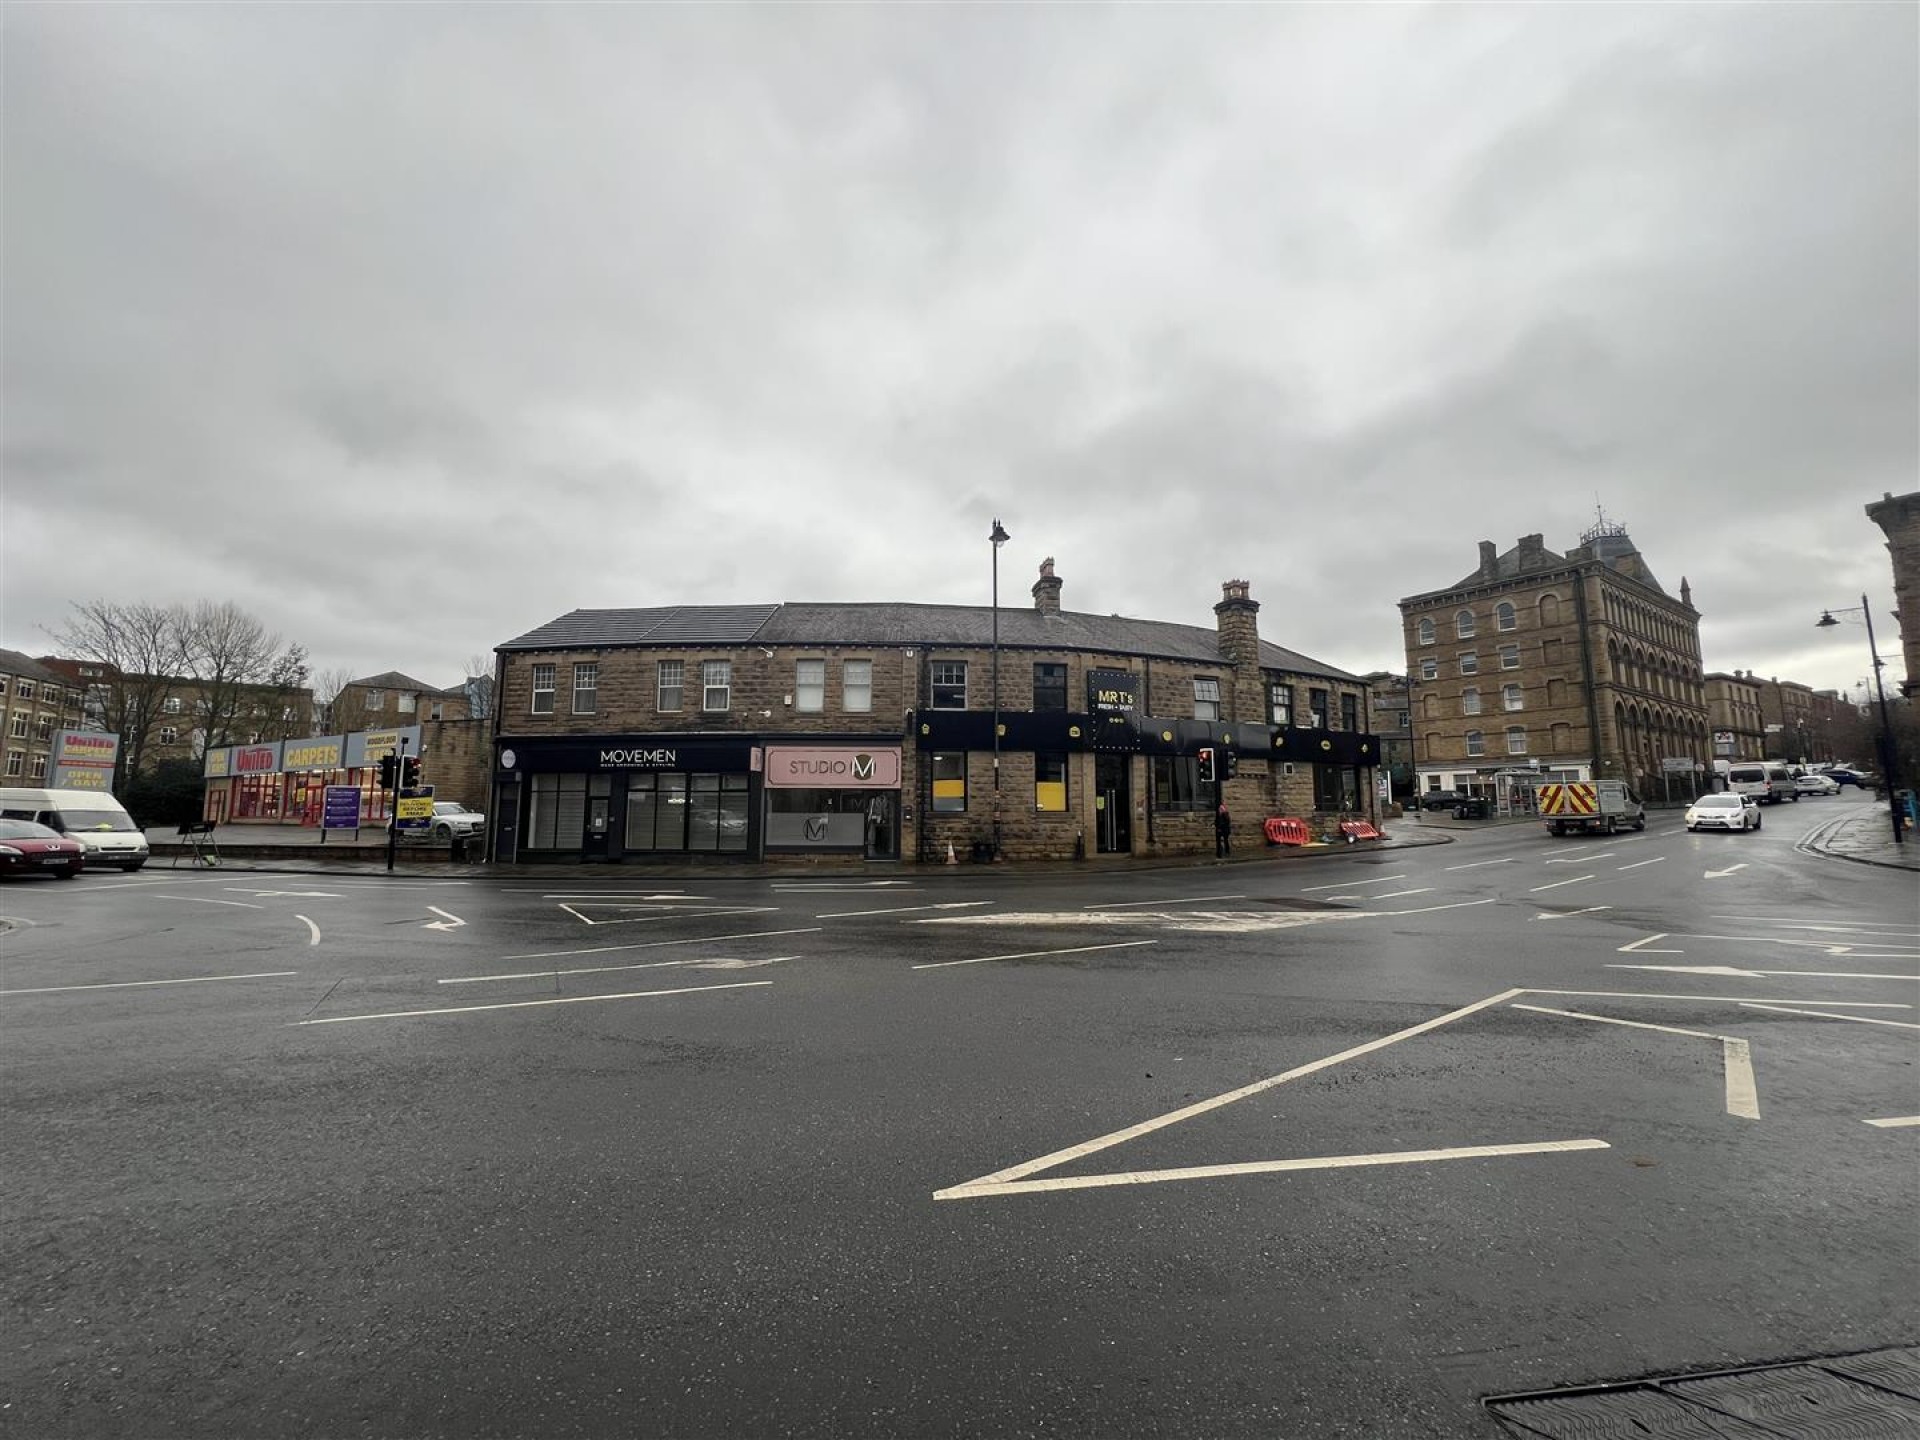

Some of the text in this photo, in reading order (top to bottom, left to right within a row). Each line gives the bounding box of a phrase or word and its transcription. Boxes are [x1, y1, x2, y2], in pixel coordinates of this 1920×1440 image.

[287, 745, 338, 769] CARPETS
[600, 748, 676, 763] MOVEMEN
[789, 755, 876, 778] STUDIO M
[67, 770, 102, 779] OPEN
[73, 779, 106, 788] DAYS
